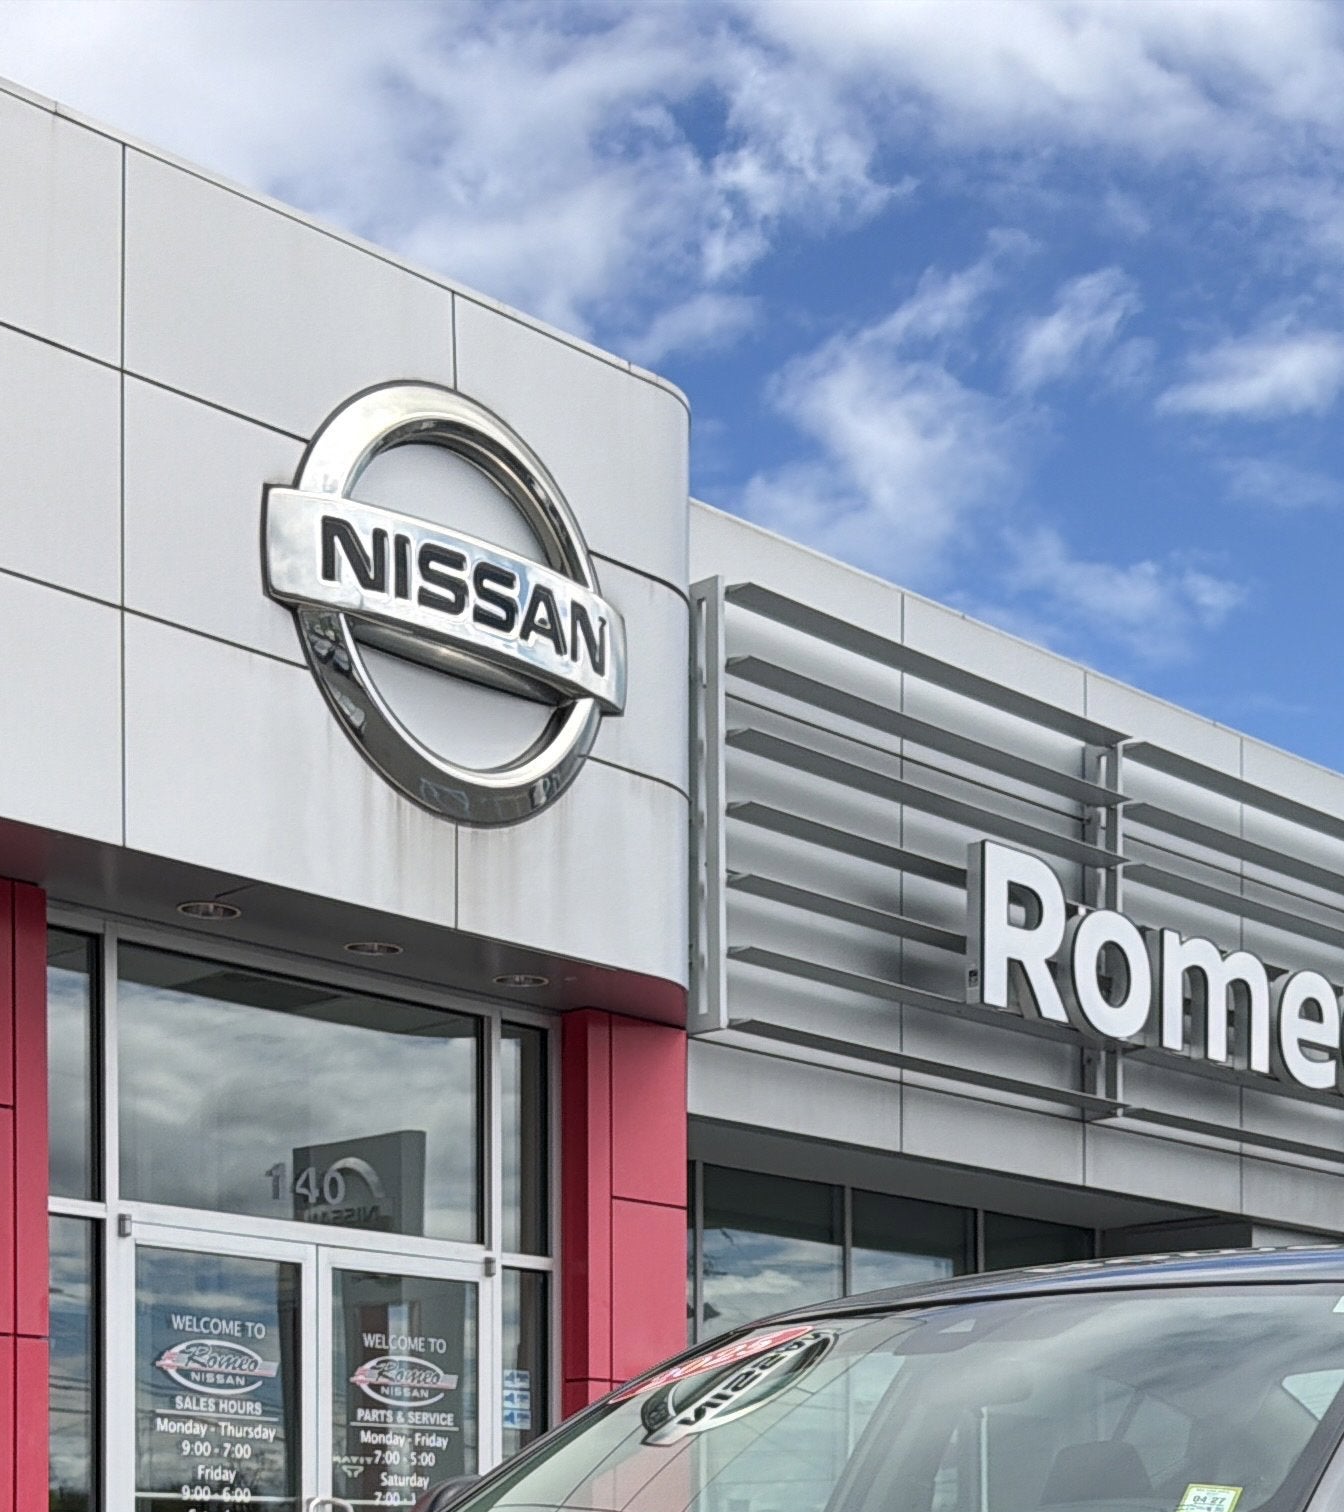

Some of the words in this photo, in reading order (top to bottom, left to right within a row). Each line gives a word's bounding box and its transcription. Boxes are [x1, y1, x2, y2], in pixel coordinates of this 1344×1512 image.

[321, 515, 606, 677] NISSAN
[265, 1162, 346, 1206] 140
[171, 1314, 242, 1337] WELCOME
[245, 1321, 266, 1339] TO
[362, 1332, 425, 1352] WELCOME
[428, 1338, 447, 1354] TO
[184, 1344, 259, 1372] Romeo
[190, 1372, 246, 1386] NISSAN
[370, 1360, 441, 1384] Romeo
[380, 1385, 429, 1398] NISSAN
[175, 1395, 215, 1412] SALES
[218, 1398, 262, 1415] HOURS
[357, 1408, 393, 1423] PARTS
[396, 1411, 406, 1424] &
[407, 1411, 454, 1426] SERVICE
[156, 1417, 207, 1438] Monday
[217, 1421, 277, 1443] Thursday
[181, 1439, 211, 1457] 9:00
[223, 1442, 252, 1459] 7:00
[360, 1430, 406, 1448] Monday
[414, 1432, 449, 1451] Friday
[373, 1450, 400, 1465] 7:00
[410, 1451, 436, 1467] 5:00
[197, 1464, 237, 1484] Friday
[380, 1471, 430, 1490] Saturday
[181, 1485, 211, 1501] 9:00
[222, 1486, 252, 1503] 6:00
[374, 1491, 400, 1506] 7:00
